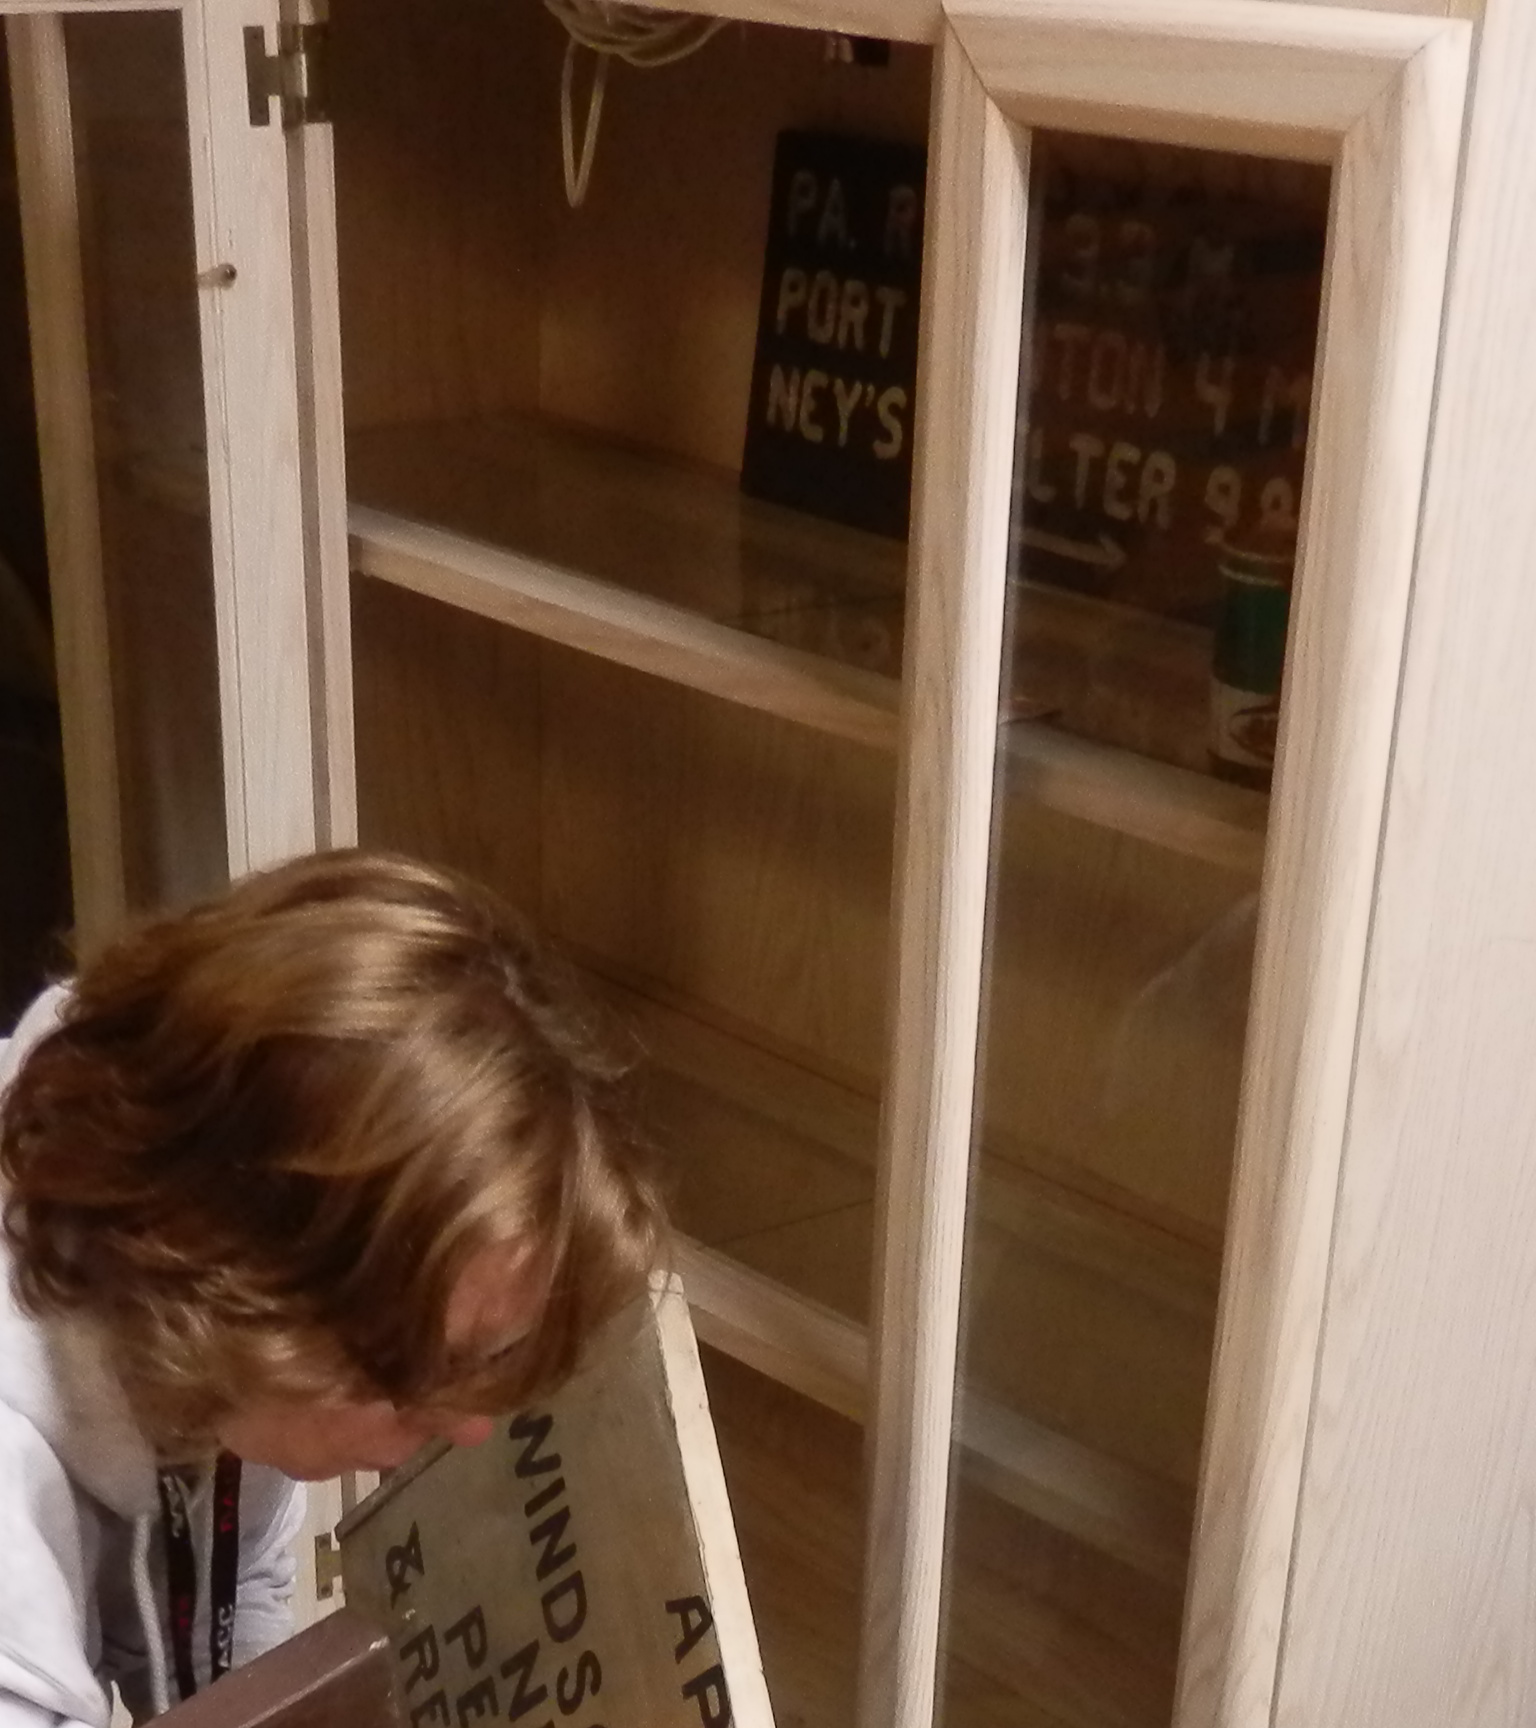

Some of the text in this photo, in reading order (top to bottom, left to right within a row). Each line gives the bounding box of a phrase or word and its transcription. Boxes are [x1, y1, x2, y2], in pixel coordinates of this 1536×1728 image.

[777, 267, 907, 359] PORT
[766, 363, 907, 460] NEY'S
[384, 1520, 425, 1610] &
